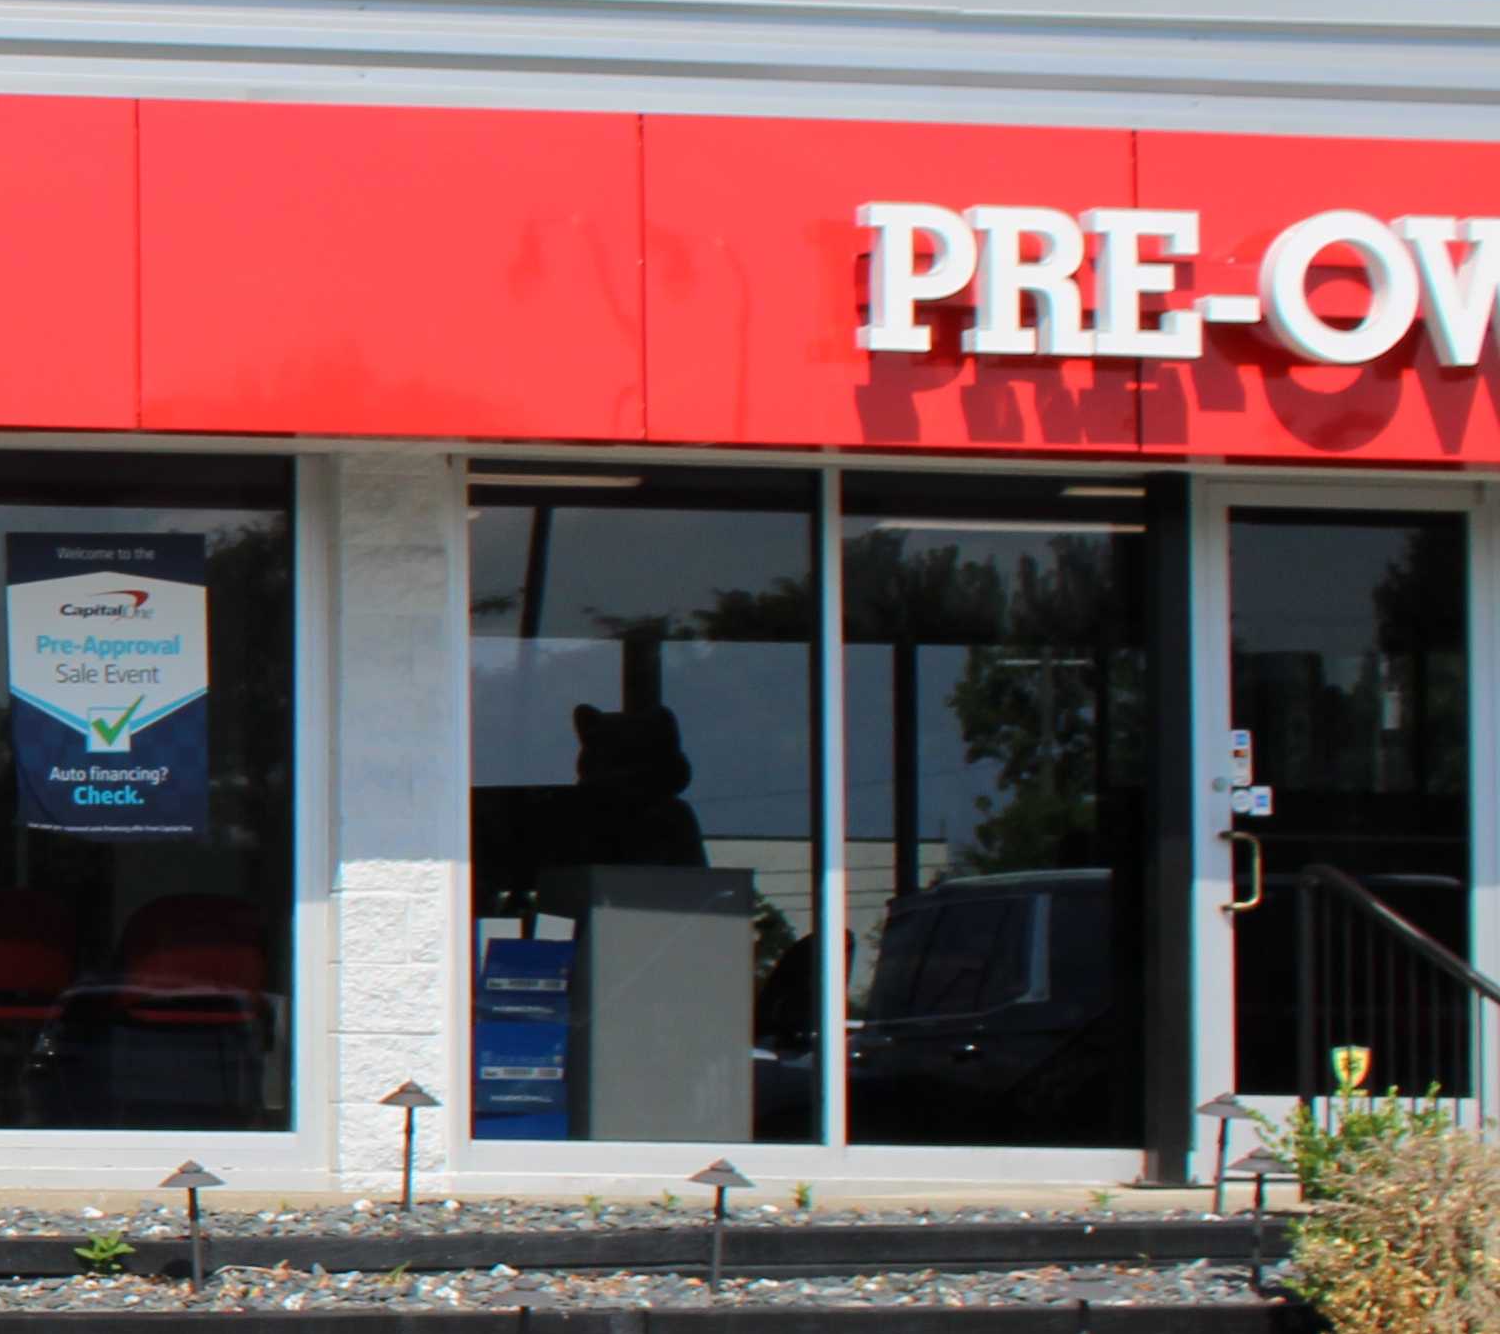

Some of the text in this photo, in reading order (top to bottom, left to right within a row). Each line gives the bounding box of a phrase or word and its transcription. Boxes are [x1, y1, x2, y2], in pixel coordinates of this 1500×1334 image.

[57, 547, 155, 561] Welcome to the
[36, 635, 181, 659] Pre-Approval
[56, 664, 160, 684] Sale Event
[49, 766, 169, 787] Auto financing?
[74, 785, 145, 805] Check.
